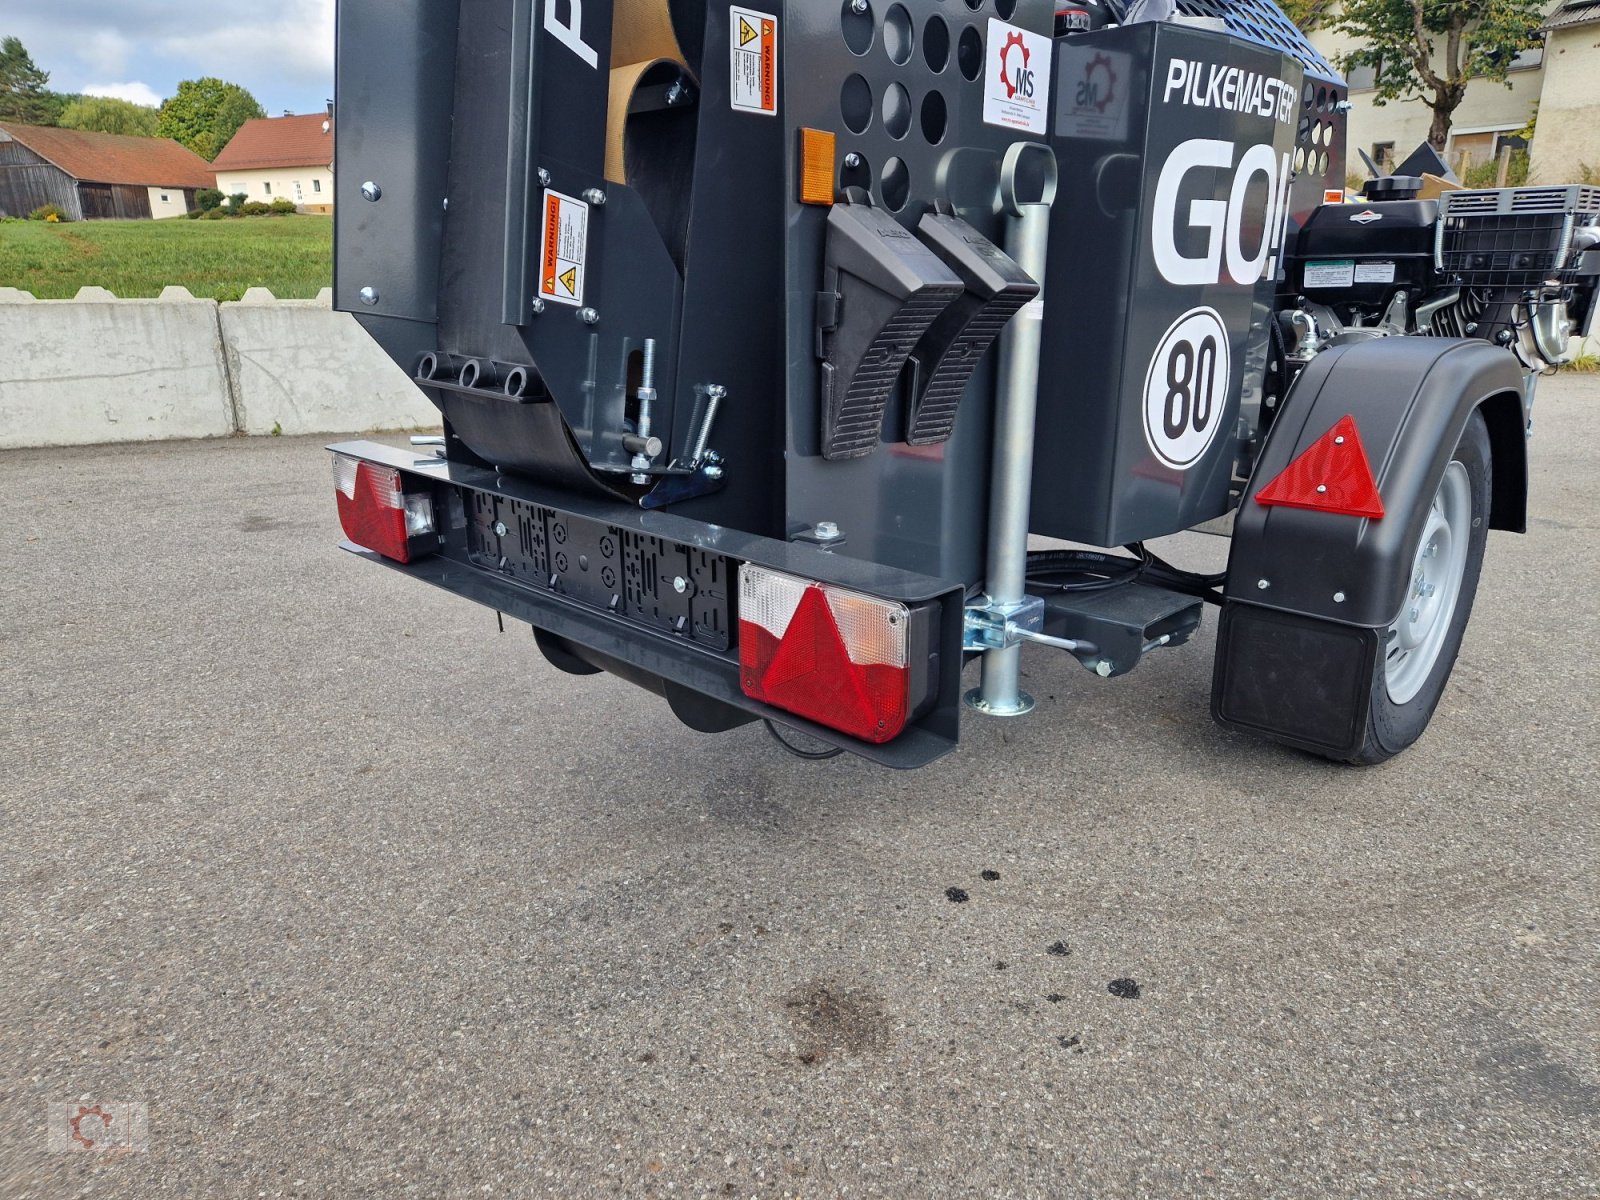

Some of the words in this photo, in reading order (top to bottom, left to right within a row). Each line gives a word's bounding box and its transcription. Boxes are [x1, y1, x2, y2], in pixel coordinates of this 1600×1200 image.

[1016, 67, 1034, 98] MS
[1163, 58, 1294, 125] PILKEMASTER
[547, 201, 557, 267] WARNUNG!
[1152, 138, 1290, 286] GO!
[1163, 334, 1217, 440] 80
